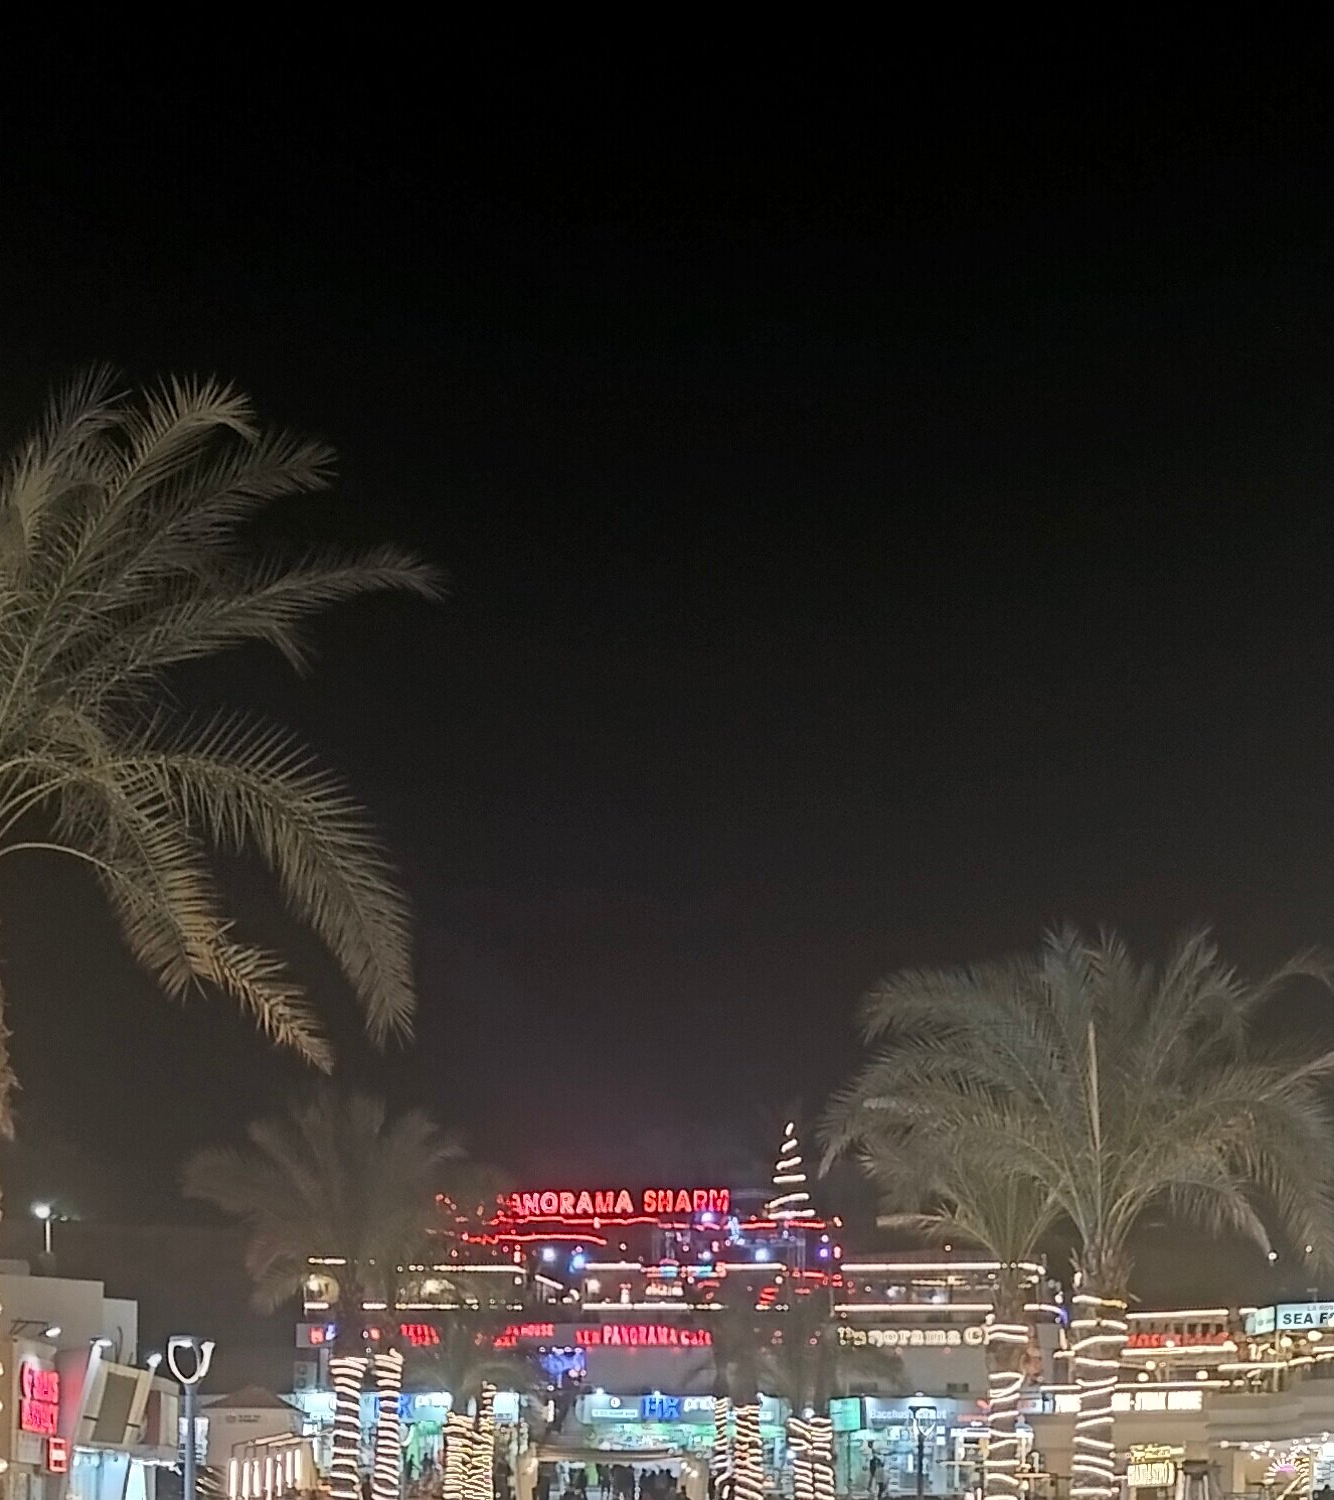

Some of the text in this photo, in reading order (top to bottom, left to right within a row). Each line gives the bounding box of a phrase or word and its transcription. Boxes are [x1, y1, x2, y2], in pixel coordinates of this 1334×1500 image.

[643, 1189, 730, 1213] SHARM
[1283, 1313, 1314, 1325] SEA
[603, 1325, 678, 1345] PANORAMA
